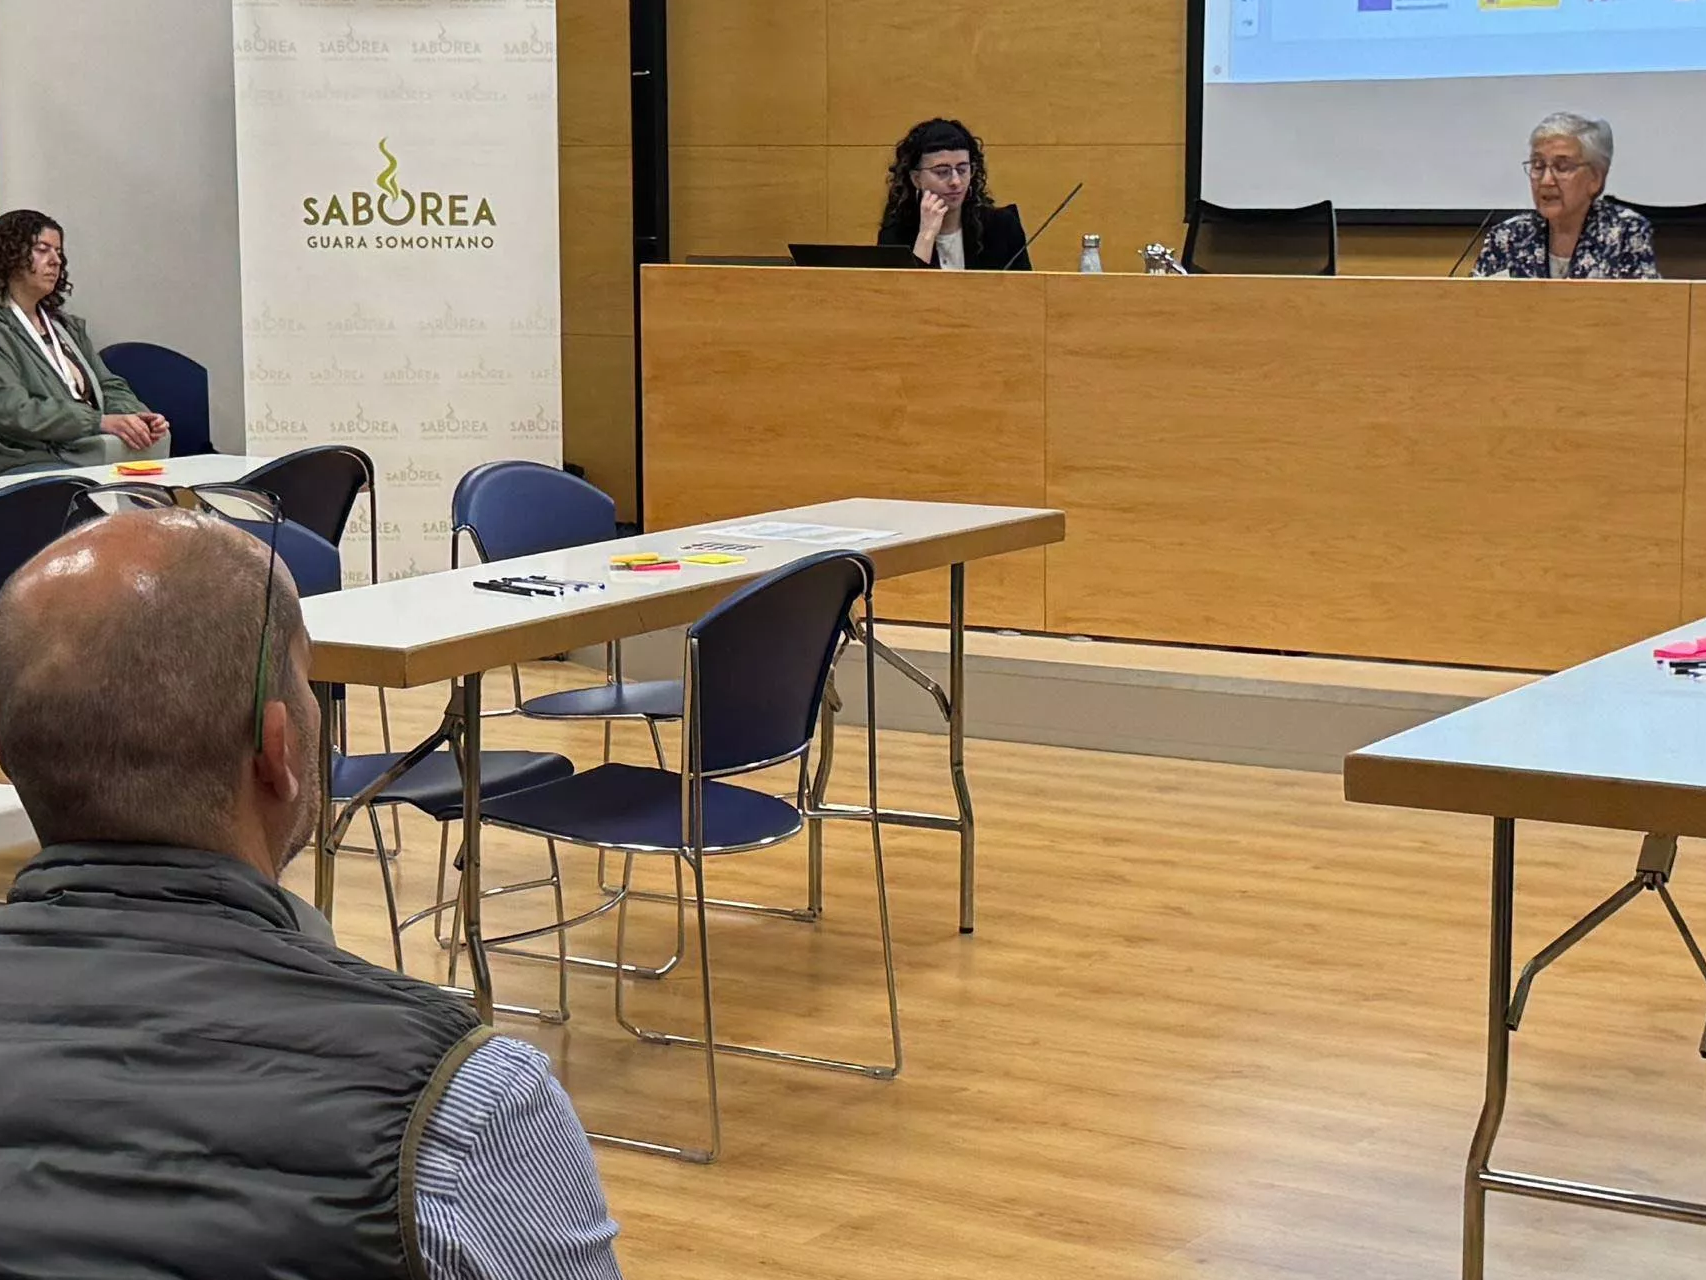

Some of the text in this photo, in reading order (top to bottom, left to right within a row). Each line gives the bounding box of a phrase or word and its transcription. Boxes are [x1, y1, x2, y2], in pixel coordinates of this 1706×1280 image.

[303, 188, 497, 226] SABOREA
[307, 236, 494, 249] GUARA SOMONTANO
